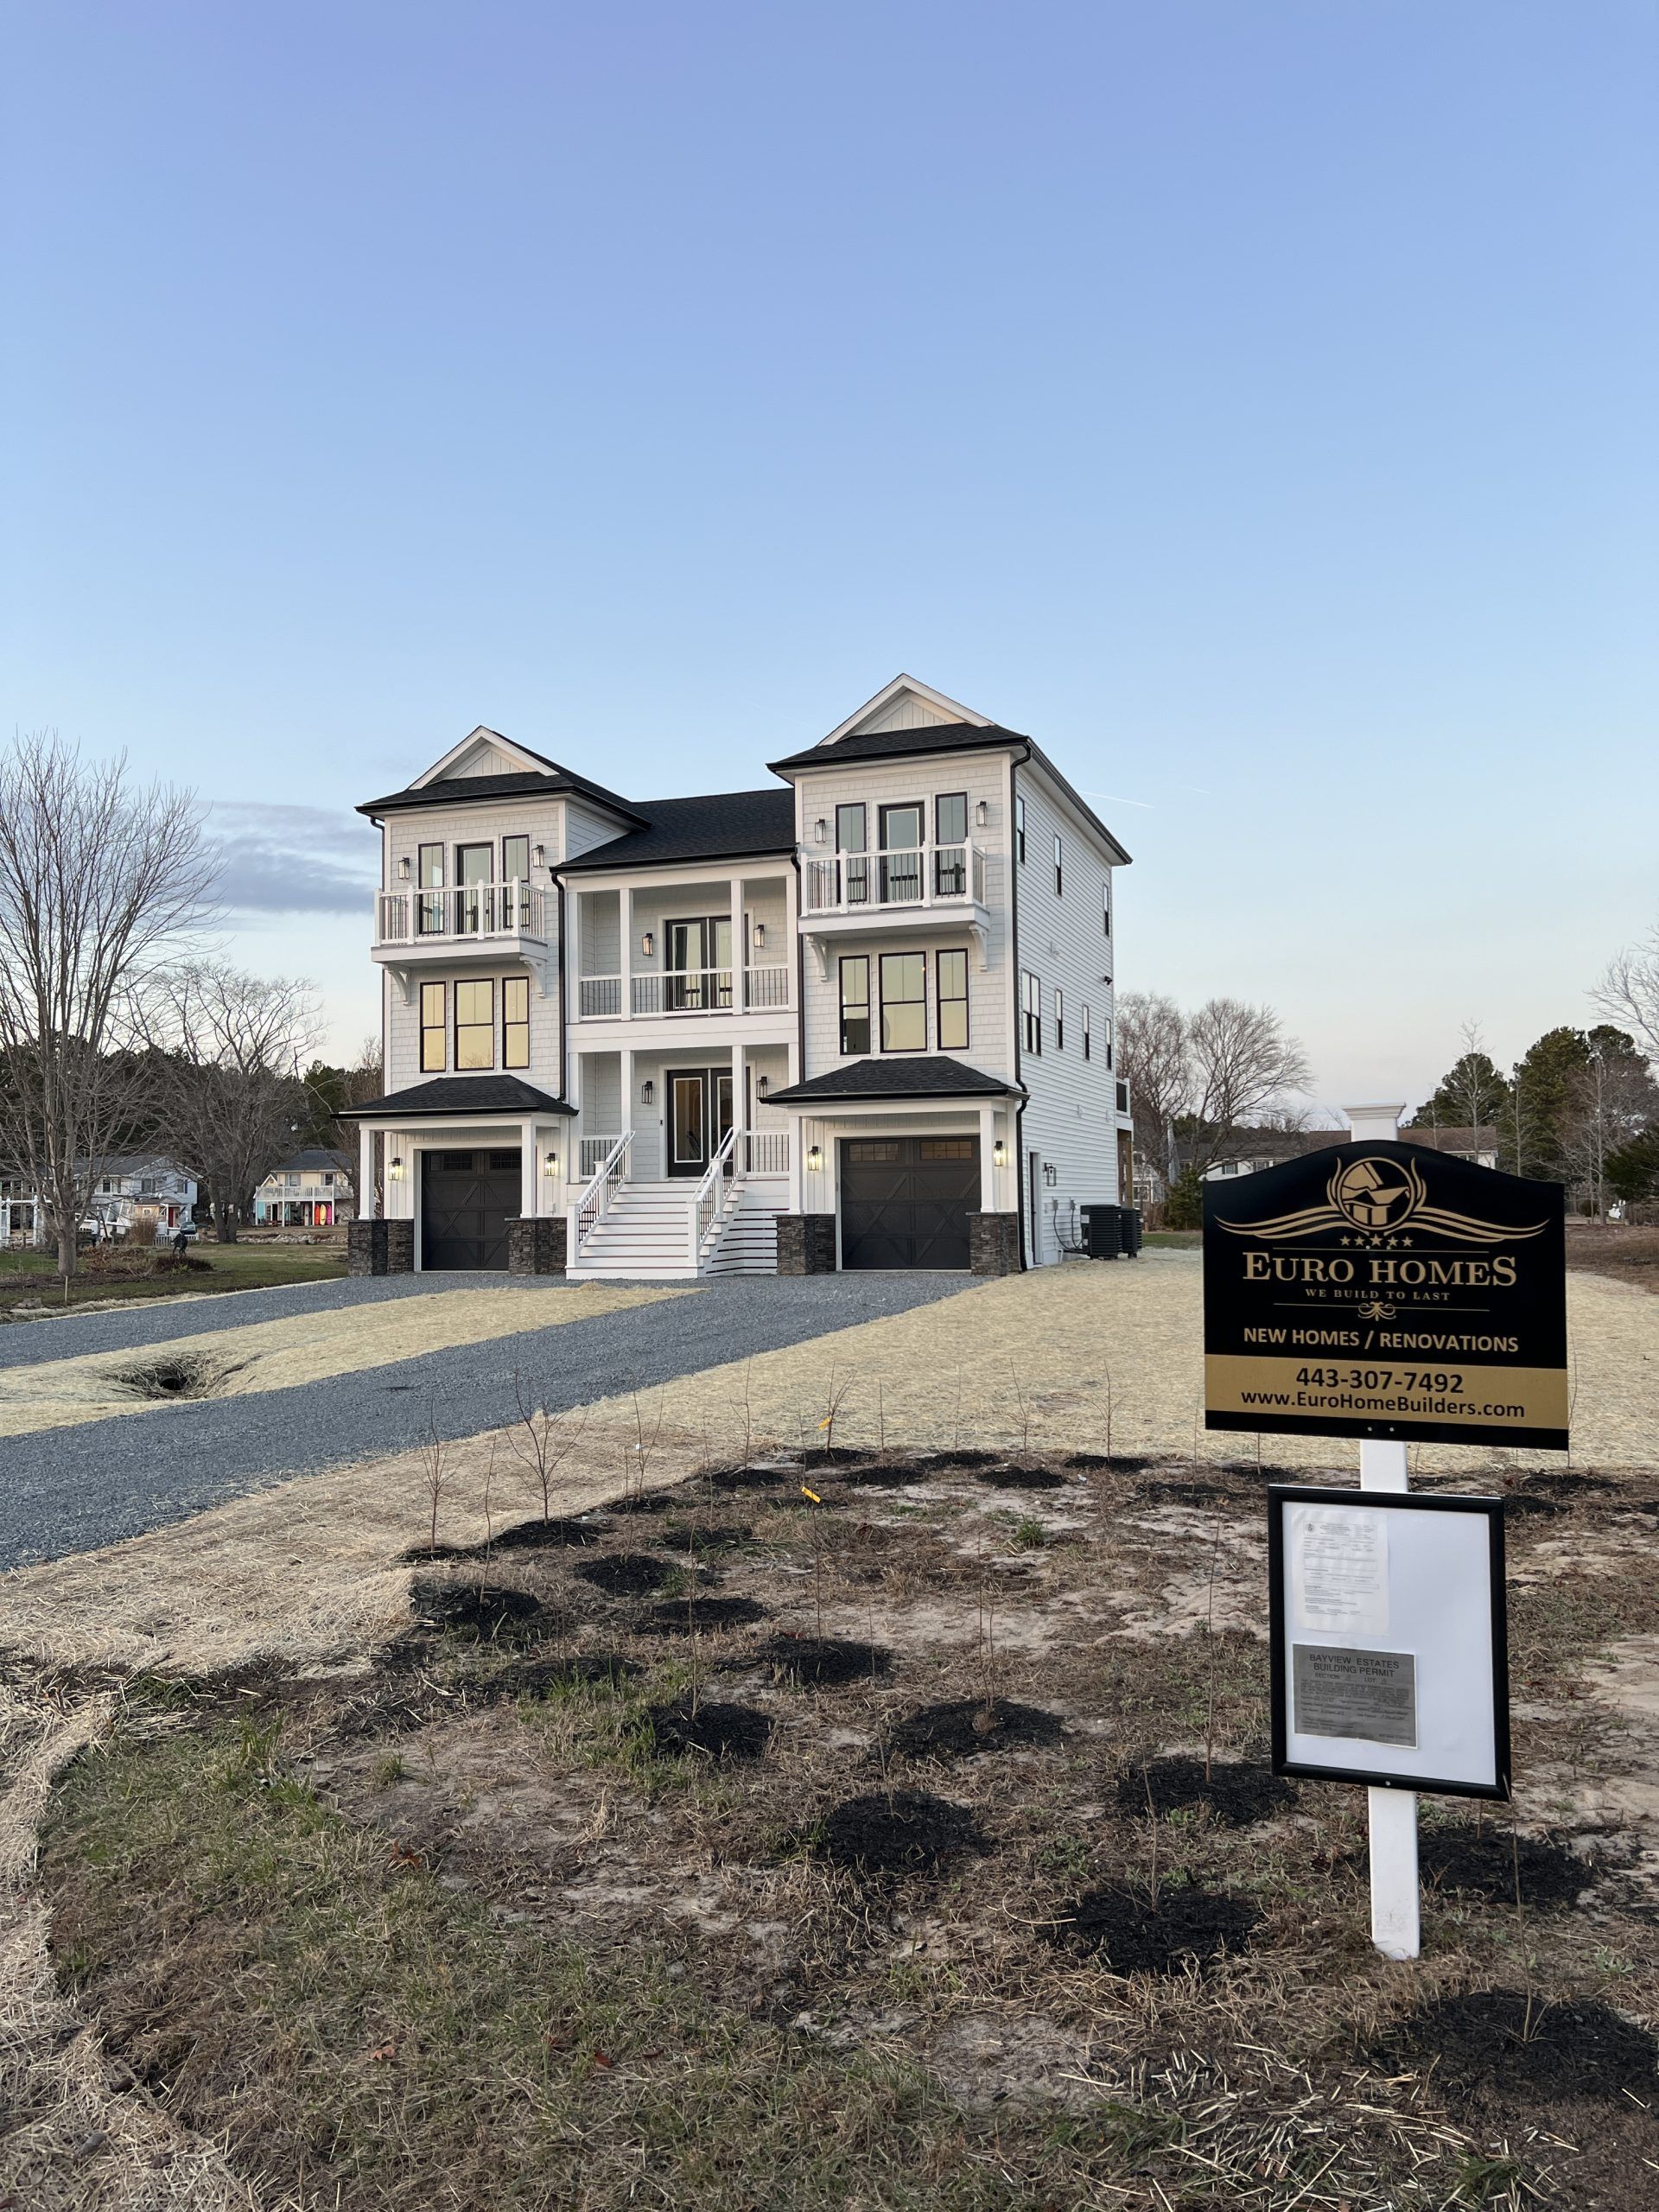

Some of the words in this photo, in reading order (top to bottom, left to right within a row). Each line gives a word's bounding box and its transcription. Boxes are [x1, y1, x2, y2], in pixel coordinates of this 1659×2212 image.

[1243, 1252, 1354, 1282] EURO
[1369, 1256, 1517, 1287] HOMES
[1306, 1288, 1326, 1297] WE
[1334, 1289, 1379, 1299] BUILD
[1386, 1291, 1406, 1300] TO
[1413, 1292, 1450, 1300] LAST
[1243, 1327, 1287, 1343] NEW
[1292, 1329, 1360, 1346] HOMES
[1380, 1332, 1519, 1352] RENOVATIONS
[1295, 1367, 1464, 1394] 443-307-7492
[1241, 1390, 1525, 1418] www.EuroHomeBuilders.com
[1309, 1654, 1351, 1664] BAYVIEW
[1356, 1658, 1400, 1669] ESTATES
[1313, 1663, 1357, 1674] BUILDING
[1359, 1667, 1395, 1677] PERMIT
